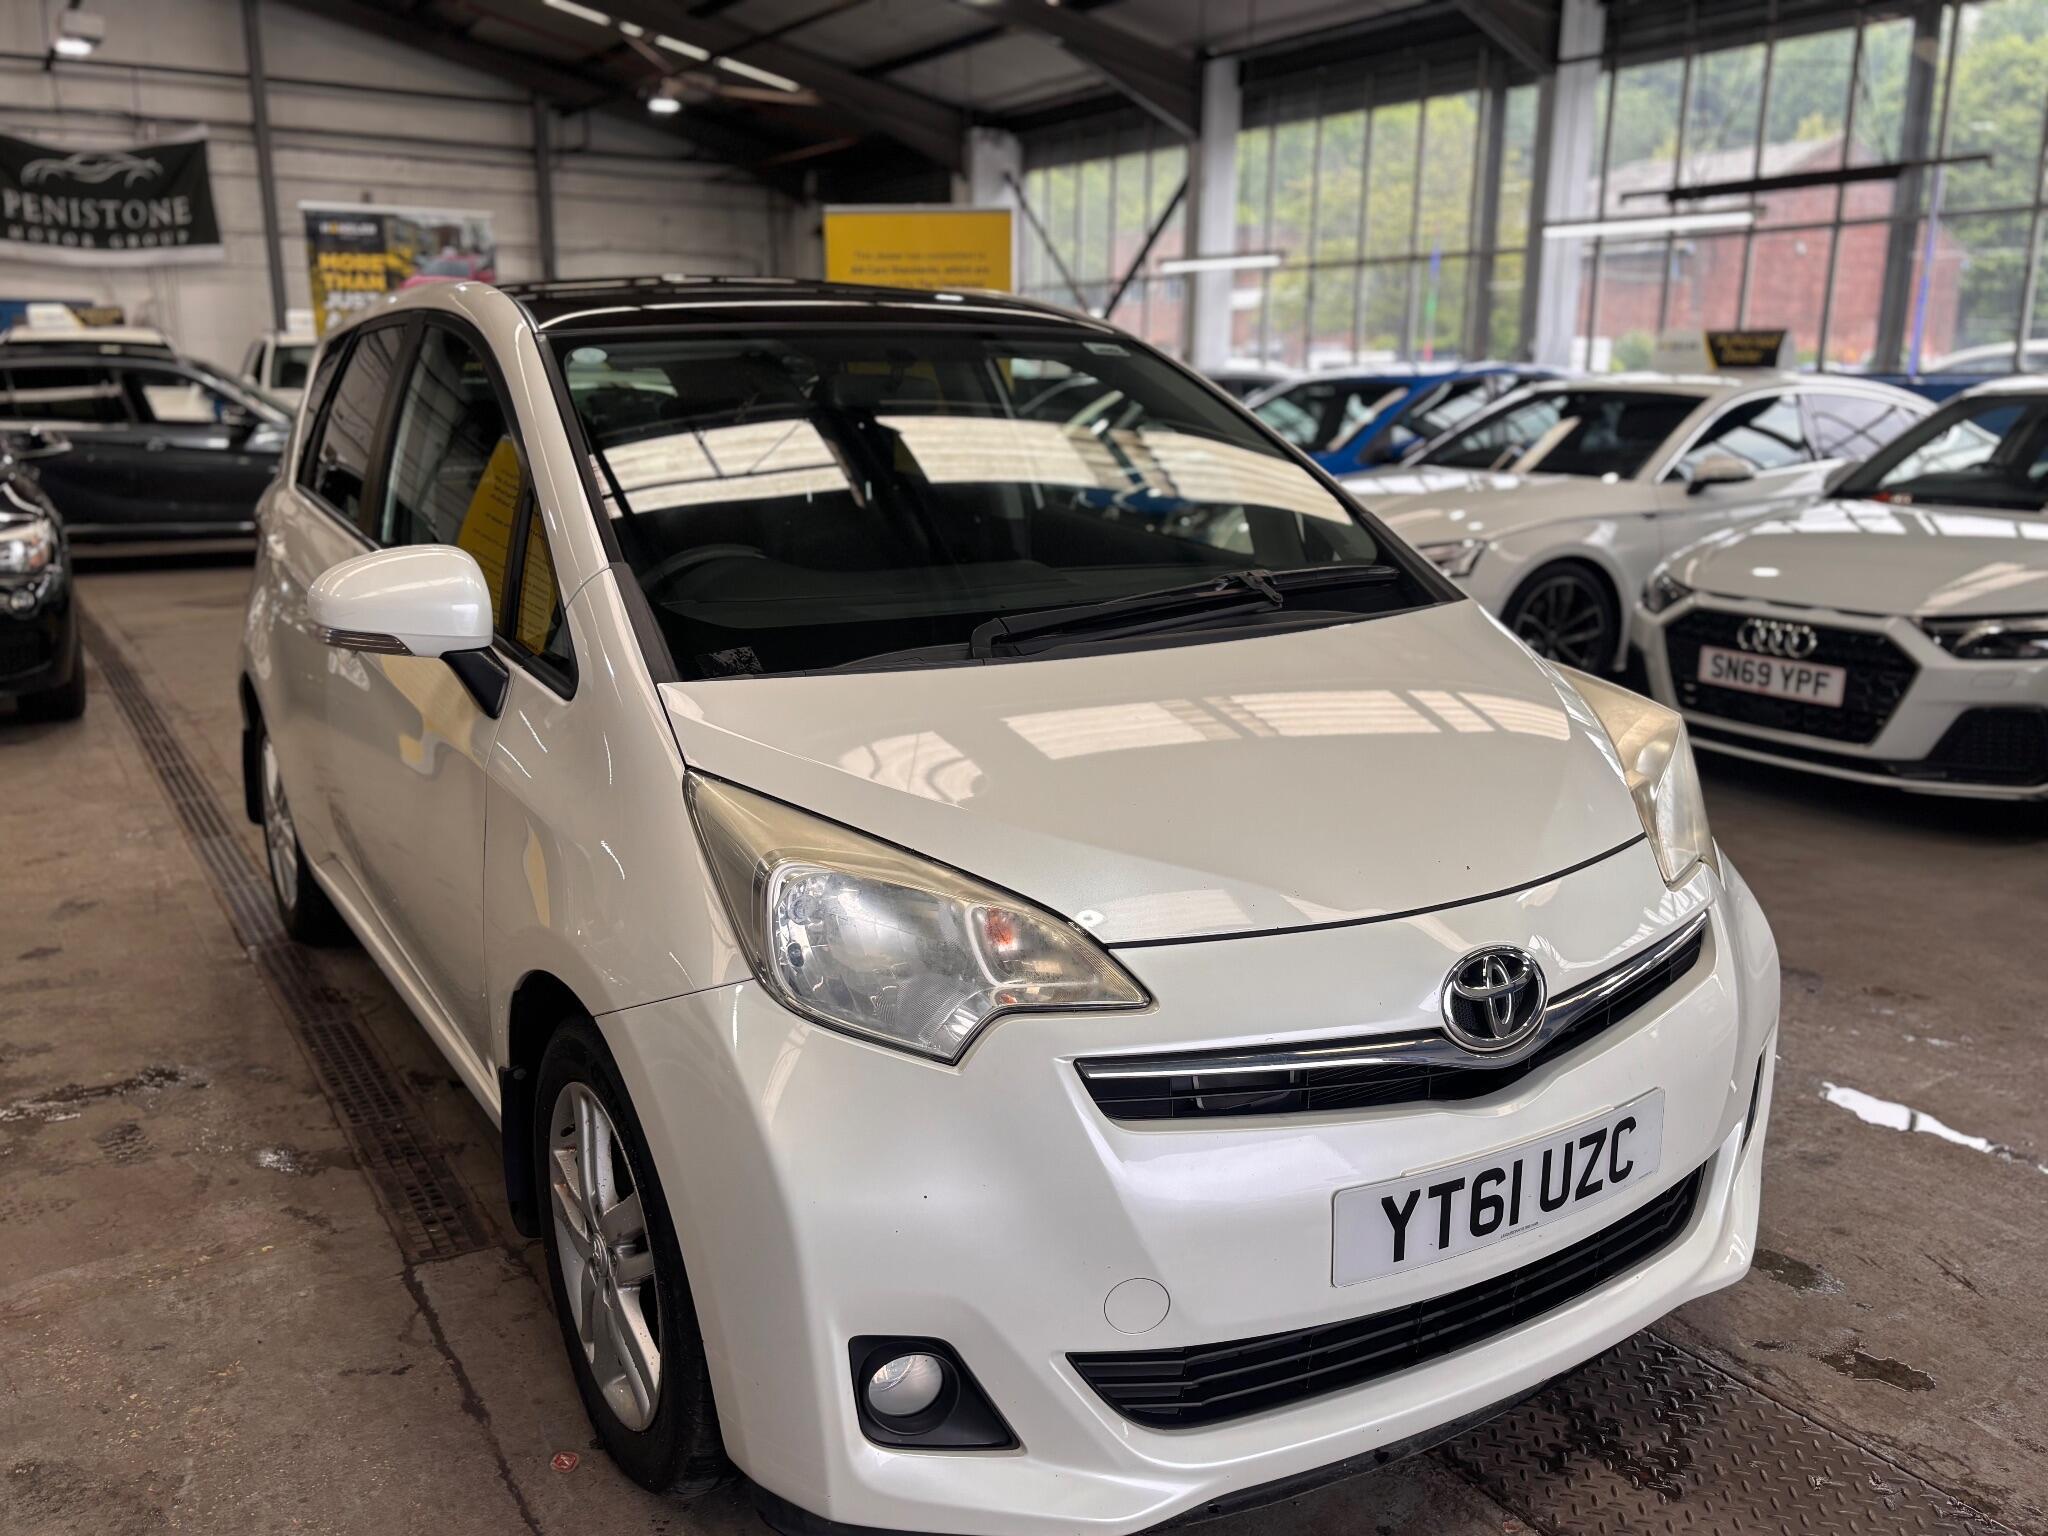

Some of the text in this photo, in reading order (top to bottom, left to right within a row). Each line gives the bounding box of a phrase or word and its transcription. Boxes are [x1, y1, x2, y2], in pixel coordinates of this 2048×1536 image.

[3, 188, 192, 229] PENISTONE
[7, 224, 95, 248] MOTOR
[318, 252, 385, 271] MORE
[322, 271, 386, 291] THAN
[1711, 654, 1831, 696] SN69 YPF
[1381, 1116, 1637, 1263] YT61 UZC
